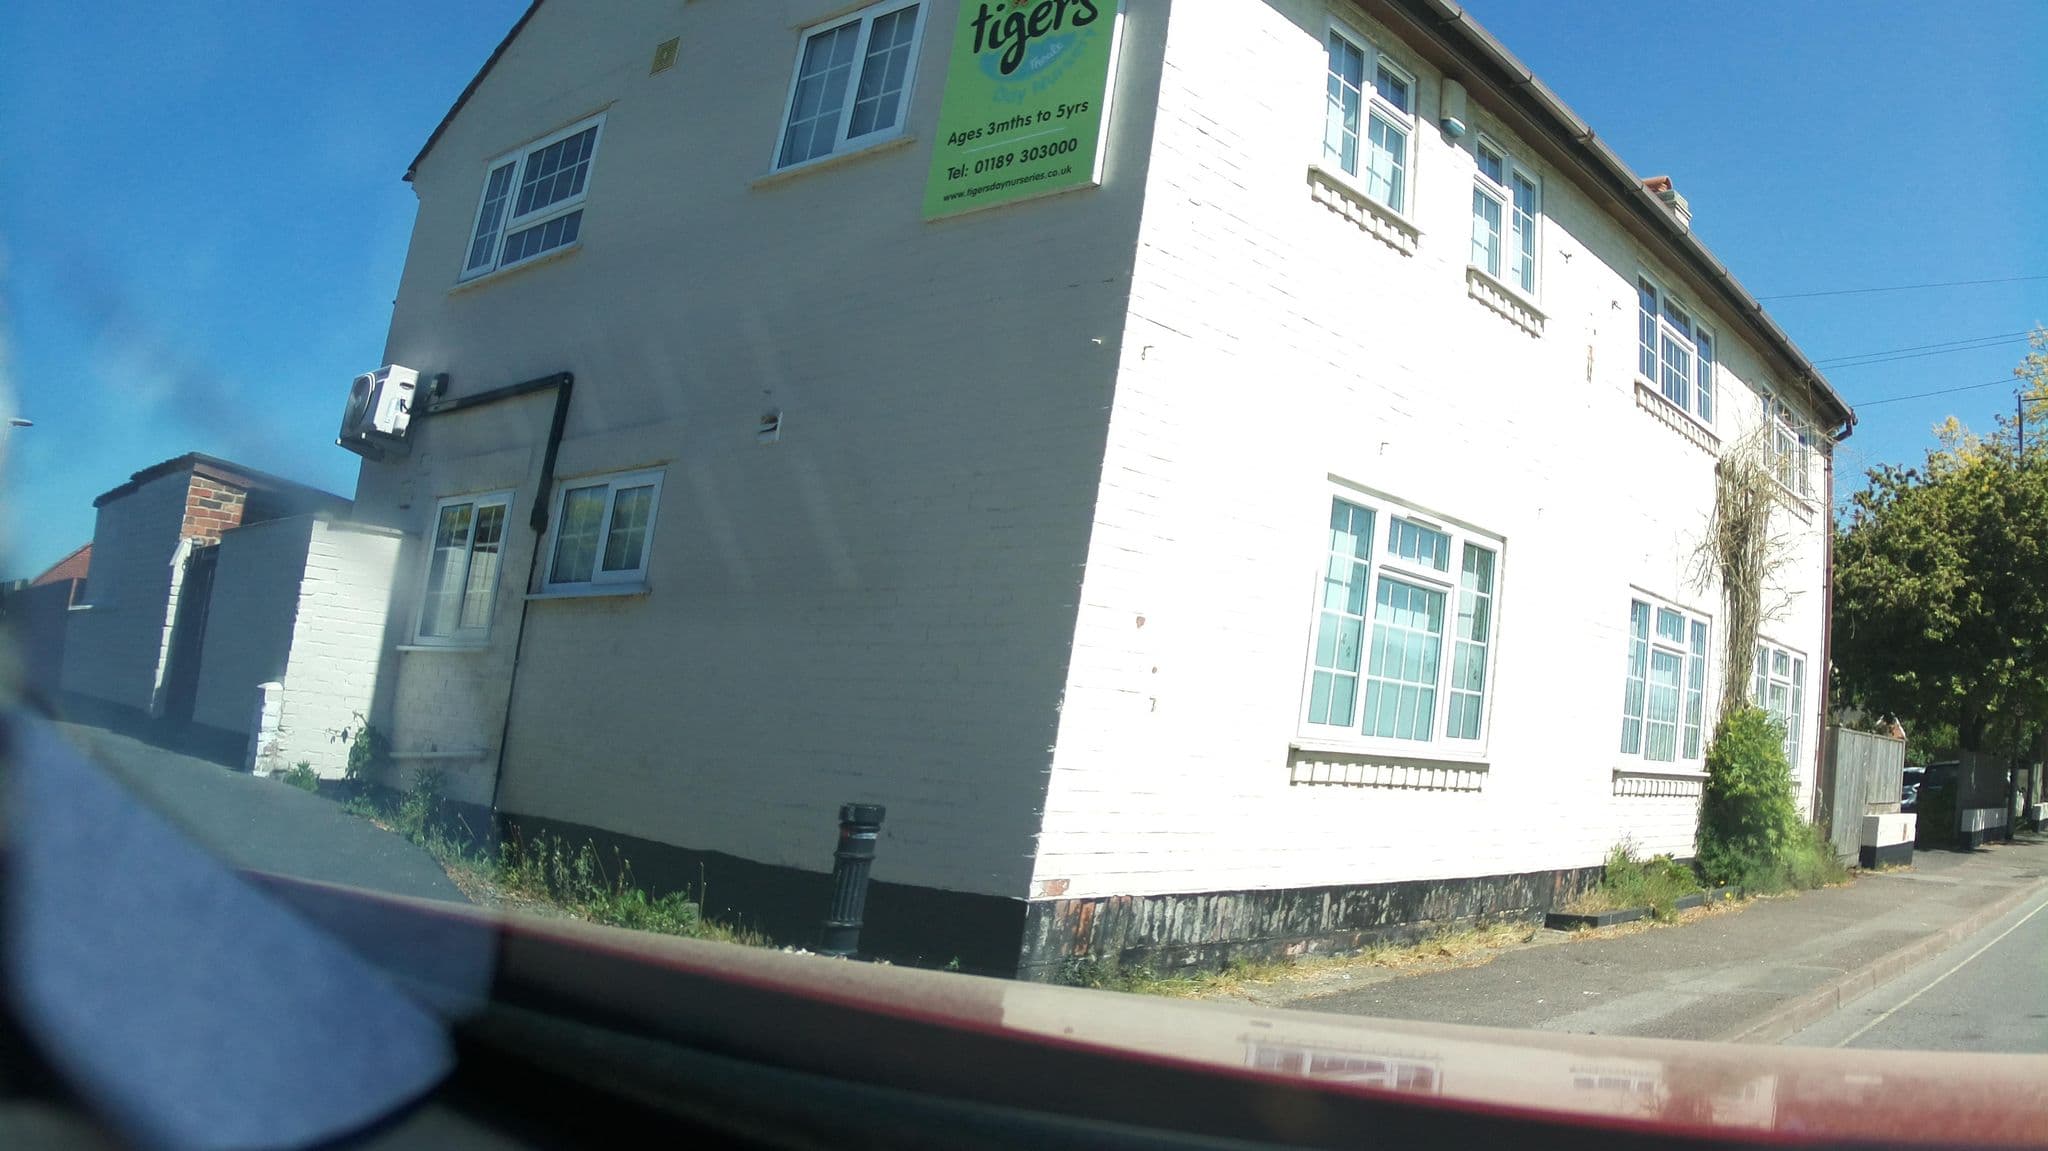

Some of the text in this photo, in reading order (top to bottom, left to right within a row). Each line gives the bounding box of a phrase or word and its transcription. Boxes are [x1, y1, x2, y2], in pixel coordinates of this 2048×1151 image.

[971, 0, 1099, 75] tigers
[947, 101, 1089, 147] Ages 3mths to 5yrs
[947, 138, 1078, 181] Tel: 01189 303000
[943, 165, 1072, 201] www.tigersdaynurseries.co.uk
